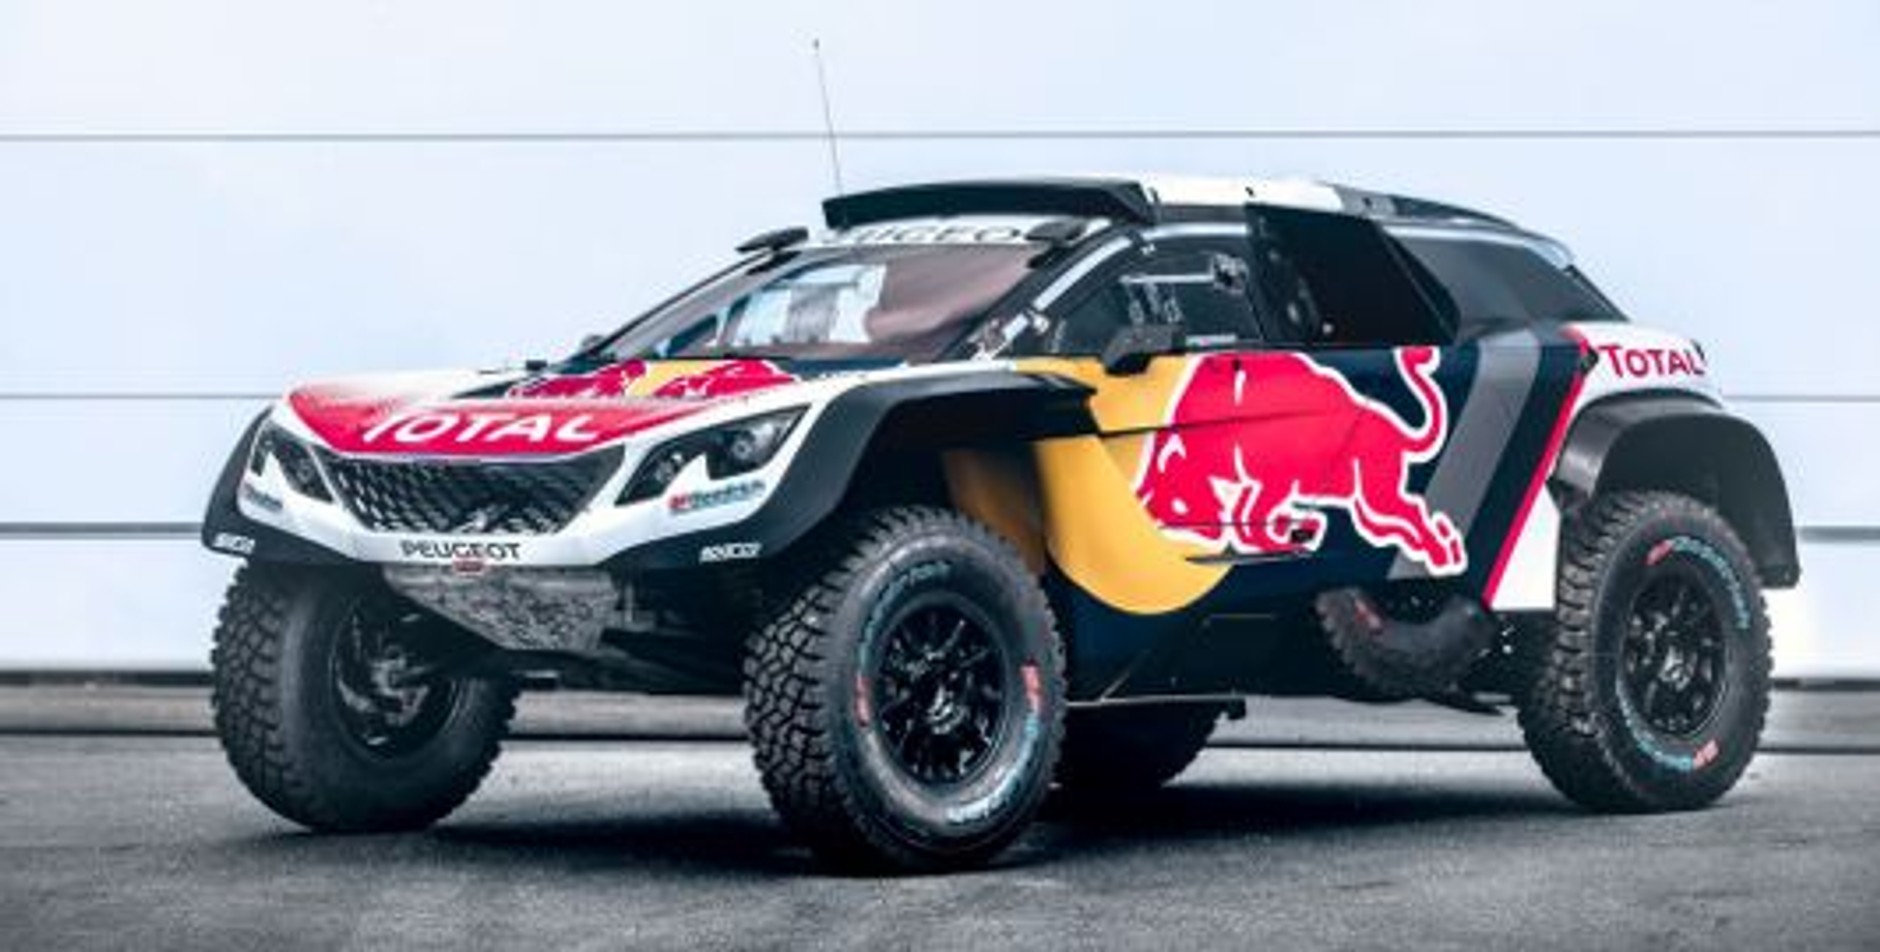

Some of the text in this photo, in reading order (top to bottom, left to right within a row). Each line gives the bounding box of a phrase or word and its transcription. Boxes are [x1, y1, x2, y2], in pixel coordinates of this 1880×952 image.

[1597, 343, 1705, 378] TOTAL
[361, 413, 598, 443] TOTAL
[400, 541, 521, 560] PEUGEOT
